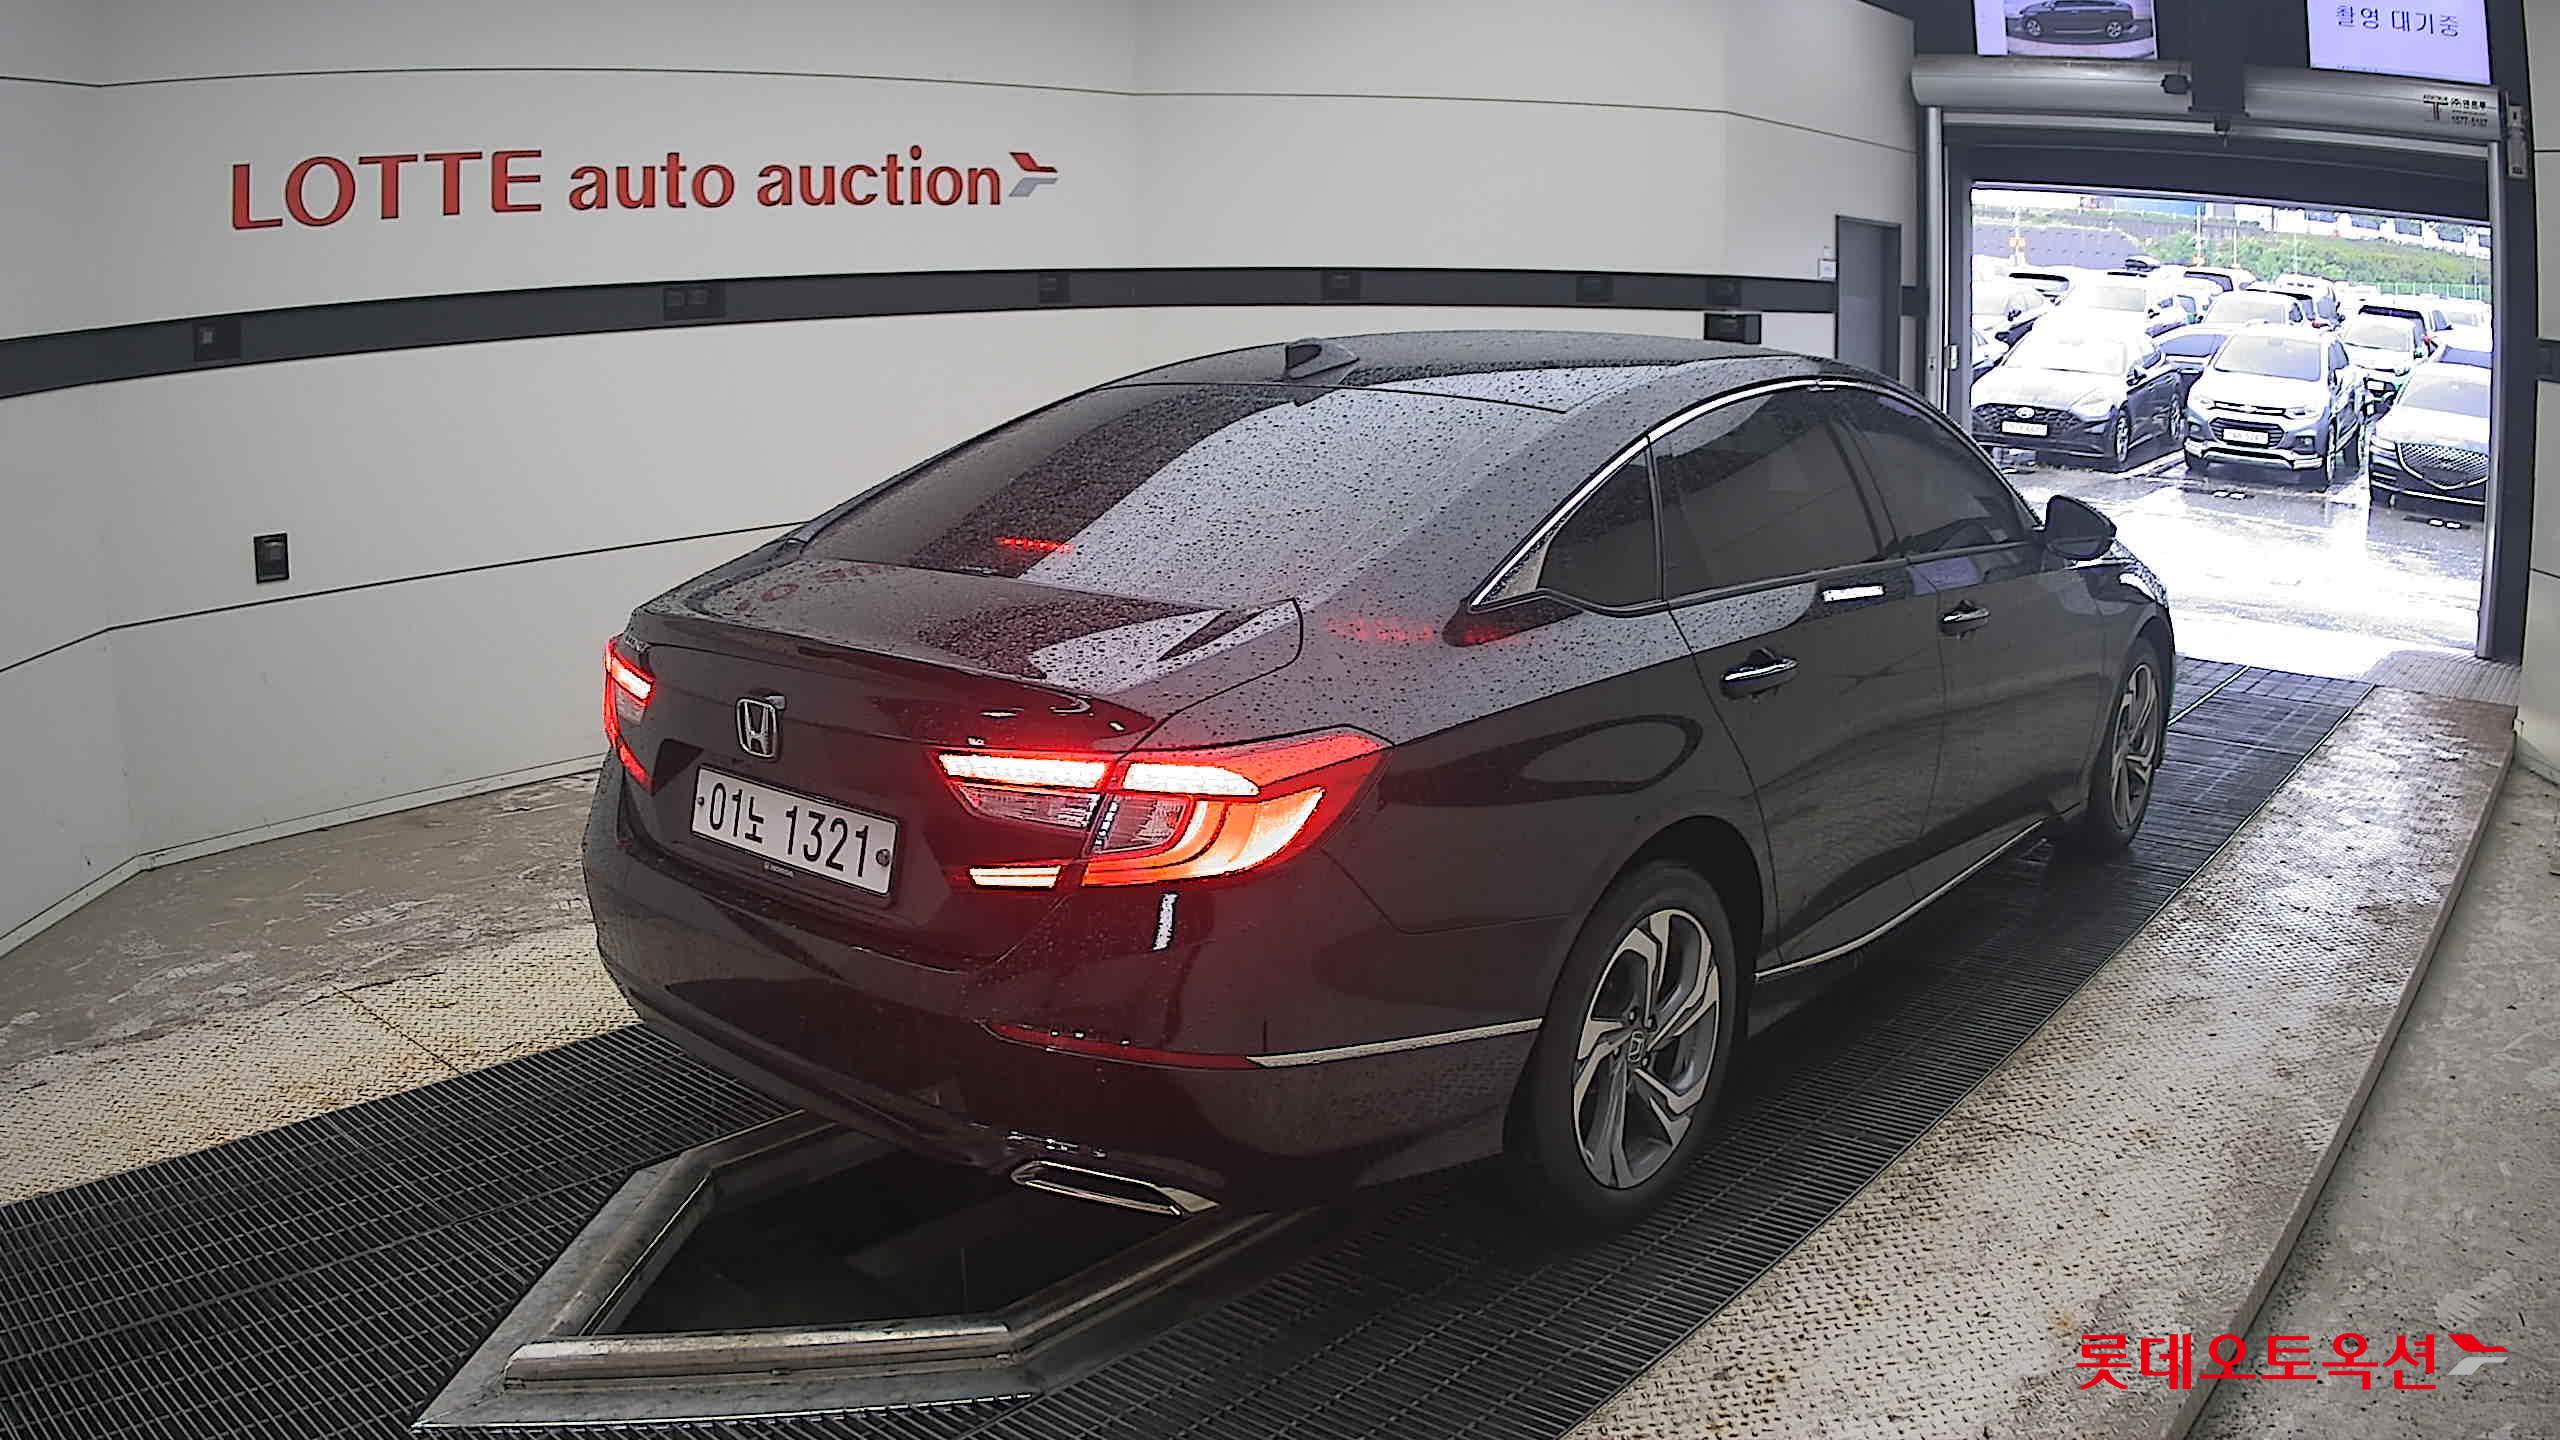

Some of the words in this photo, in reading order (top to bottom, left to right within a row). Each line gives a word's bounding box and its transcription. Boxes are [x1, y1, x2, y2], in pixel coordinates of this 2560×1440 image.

[2336, 5, 2379, 30] 촬영
[2391, 10, 2459, 37] 대기중
[232, 150, 542, 230] LOTTE
[568, 151, 735, 209] auto
[756, 146, 1001, 207] auction
[709, 782, 764, 843] 01노
[785, 805, 869, 878] 1321
